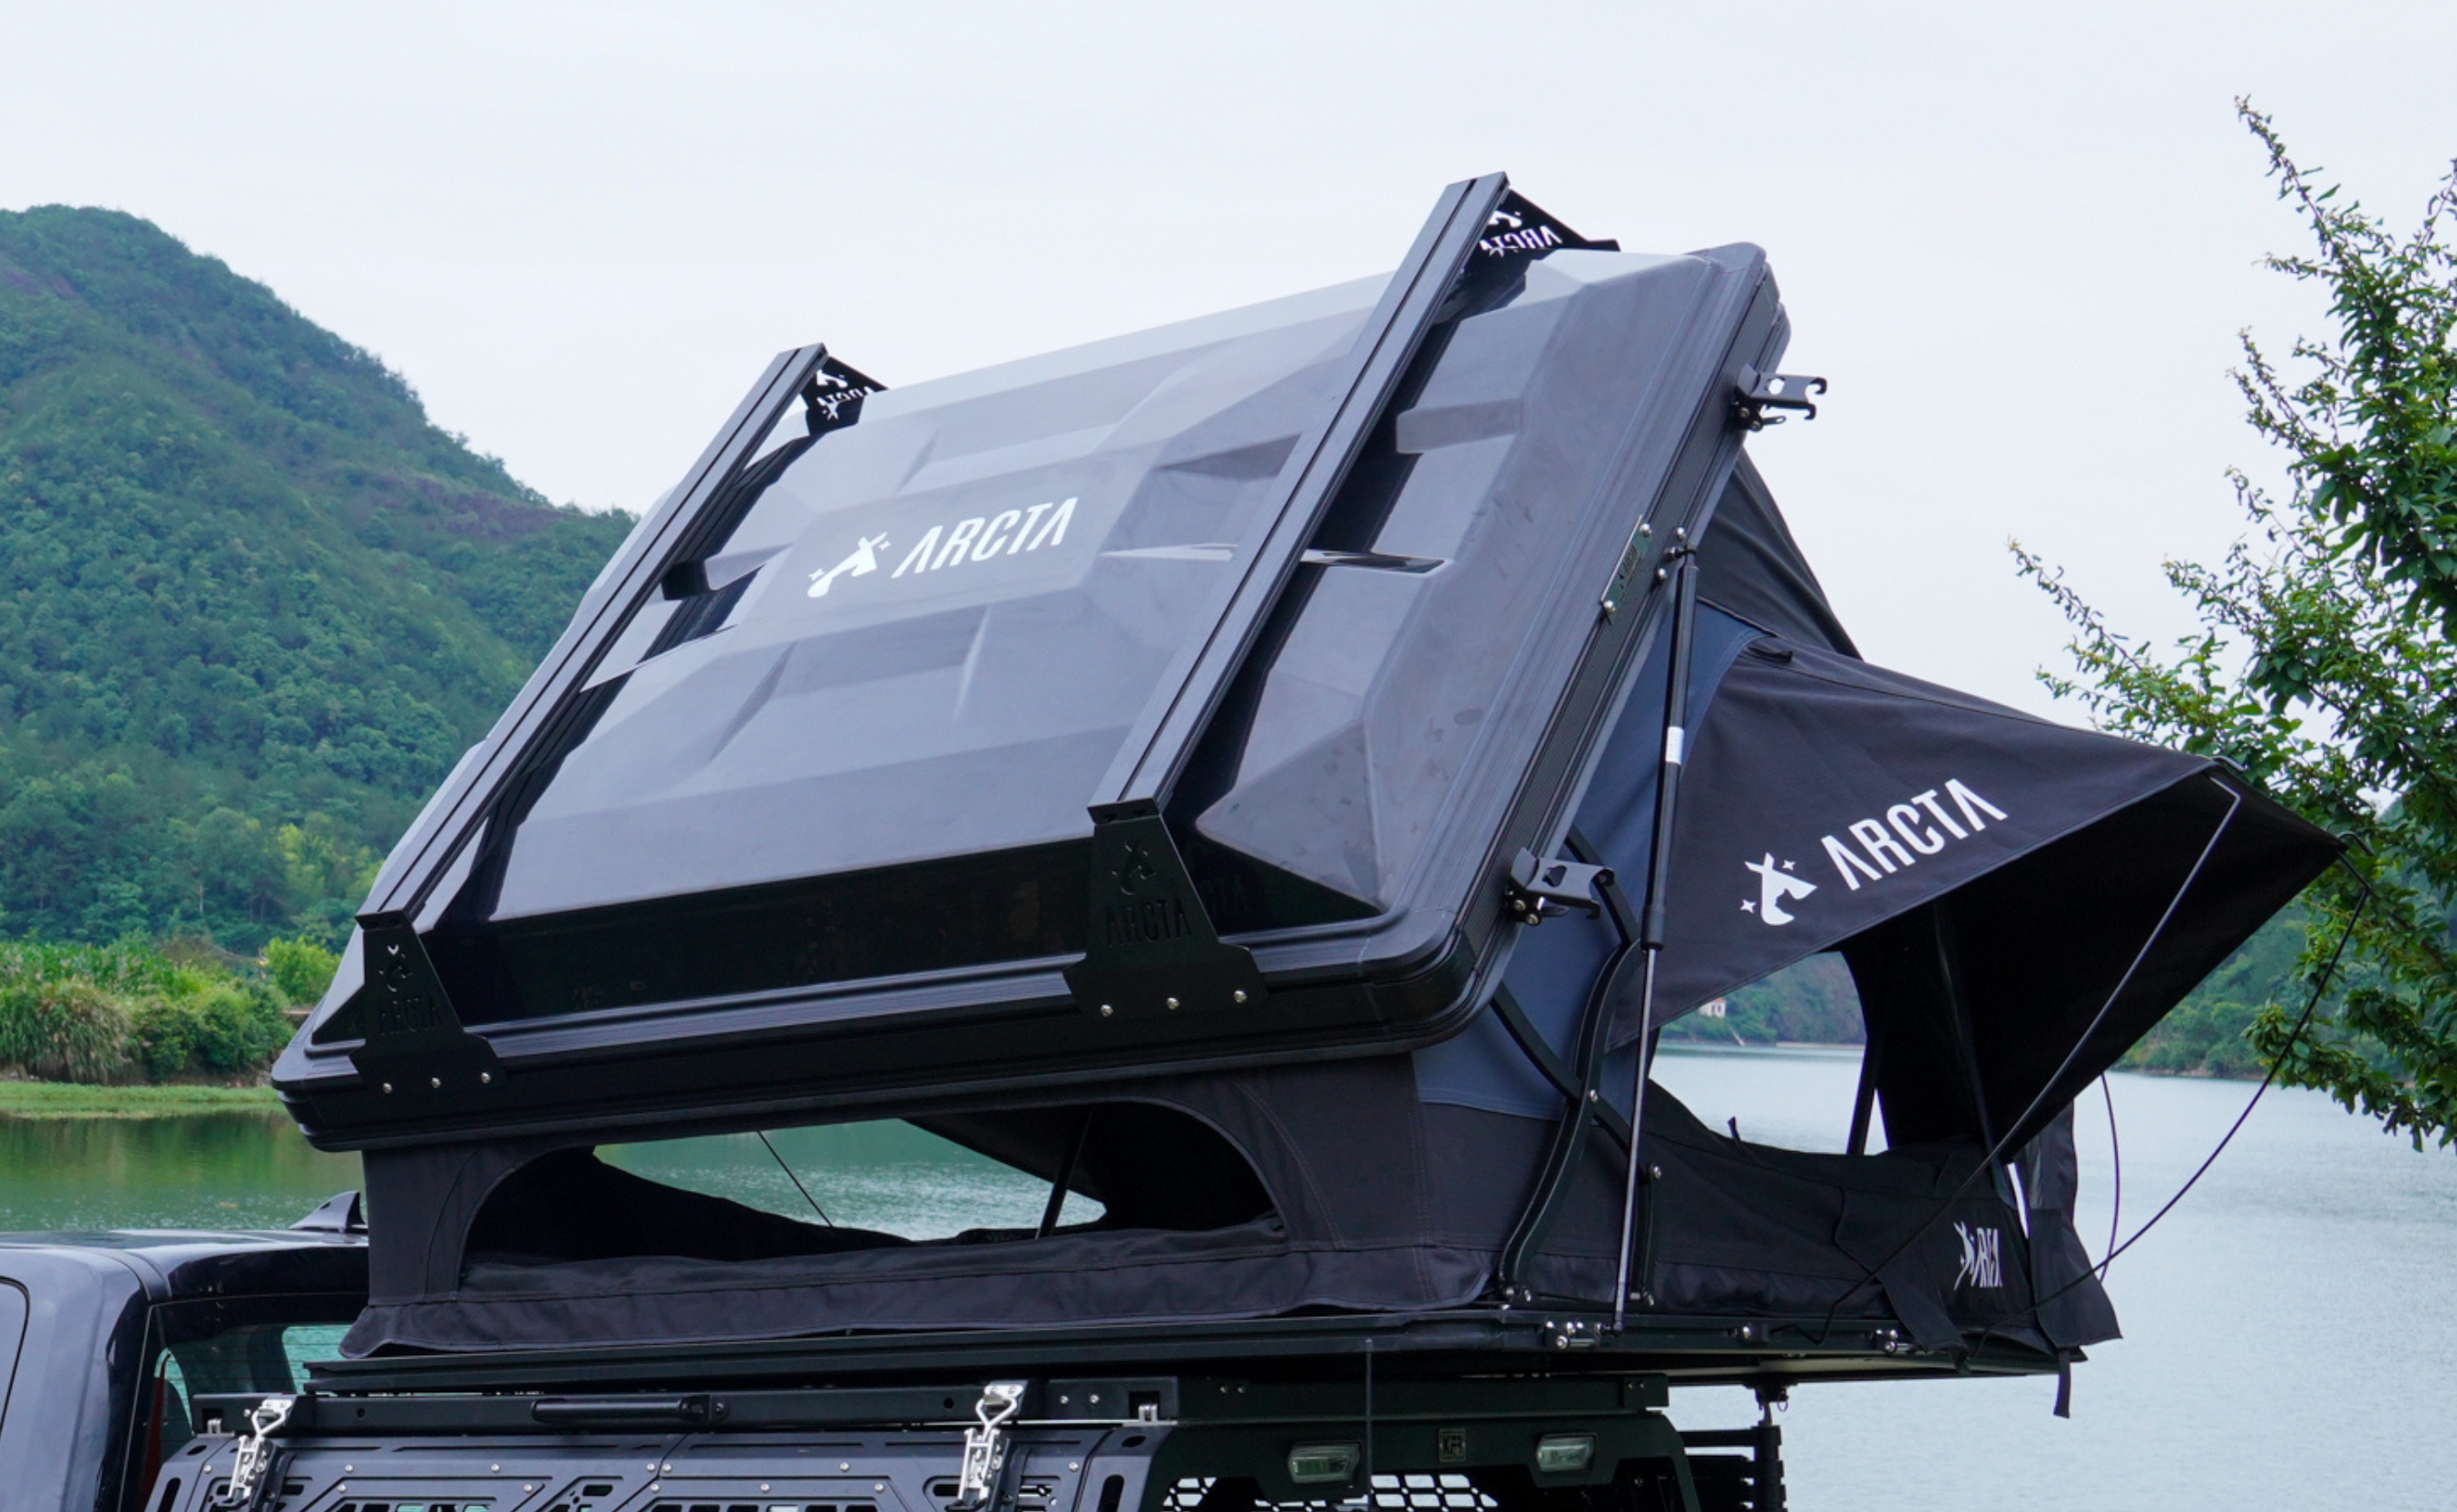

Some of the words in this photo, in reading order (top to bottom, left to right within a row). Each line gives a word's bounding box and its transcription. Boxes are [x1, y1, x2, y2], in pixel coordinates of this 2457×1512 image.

[890, 496, 1079, 579] ARCTA
[1820, 777, 2009, 892] ARCTA
[1105, 897, 1193, 947] ARCTA
